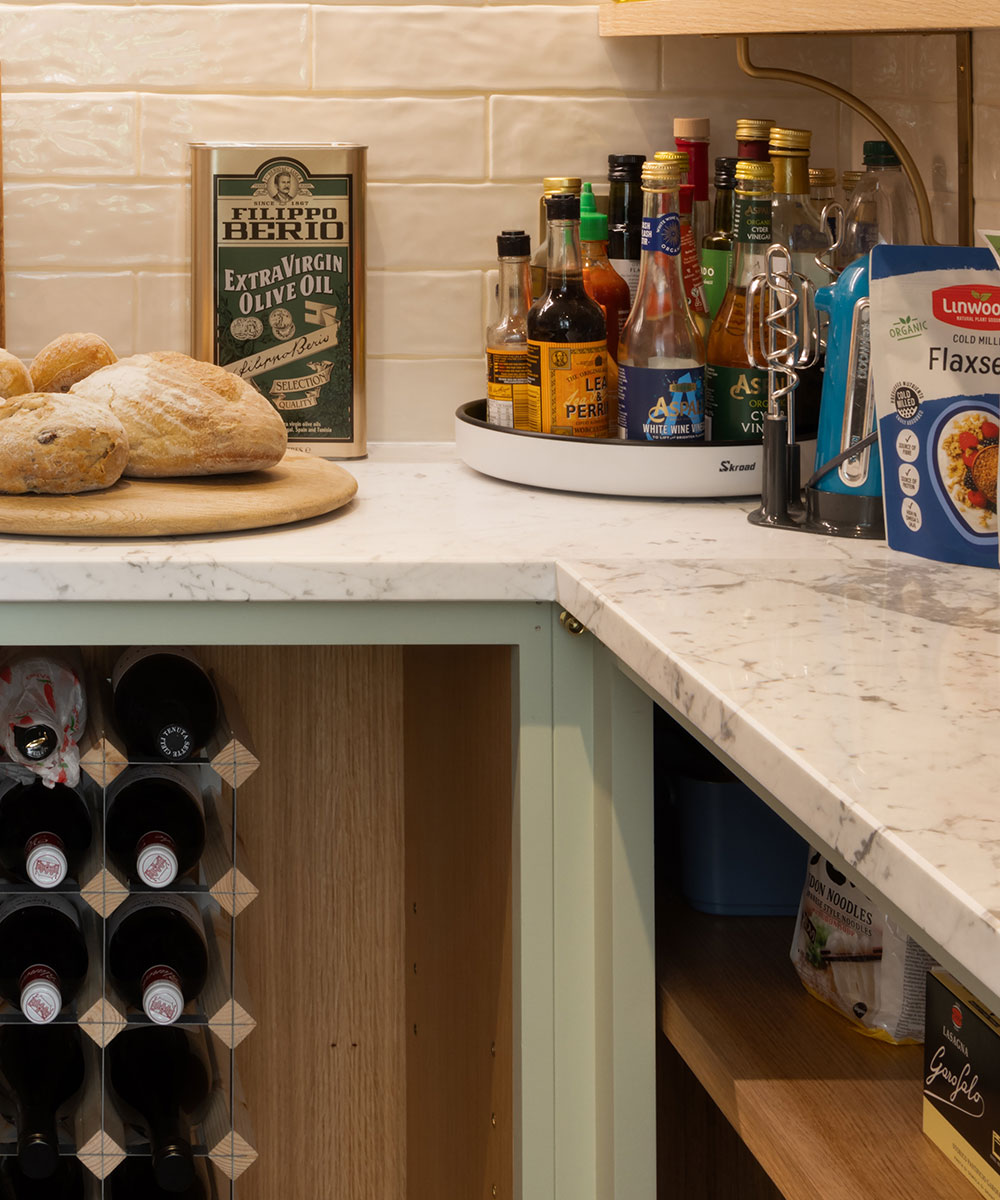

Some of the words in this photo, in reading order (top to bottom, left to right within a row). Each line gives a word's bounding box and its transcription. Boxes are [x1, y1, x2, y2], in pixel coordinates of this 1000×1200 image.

[231, 207, 337, 220] FILIPPO
[222, 221, 344, 240] BERIO
[224, 264, 285, 292] EXTRA
[280, 253, 343, 279] VIRGIN
[238, 281, 297, 315] OLIVE
[299, 273, 333, 297] OIL
[889, 320, 928, 338] ORGANIC
[953, 334, 976, 344] COLD
[275, 371, 327, 391] SELECTION
[278, 398, 313, 409] QUALITY
[896, 390, 911, 400] COLD
[642, 423, 668, 434] WHITE
[670, 423, 690, 434] WINE
[719, 460, 756, 473] Skroad
[162, 726, 189, 741] TENUTA
[172, 740, 191, 758] SETTE
[827, 887, 873, 926] NOODLES
[823, 902, 841, 921] STYLE
[841, 914, 872, 938] NOODLES
[942, 1024, 970, 1059] LASAGNA
[925, 1045, 982, 1103] Garofalo
